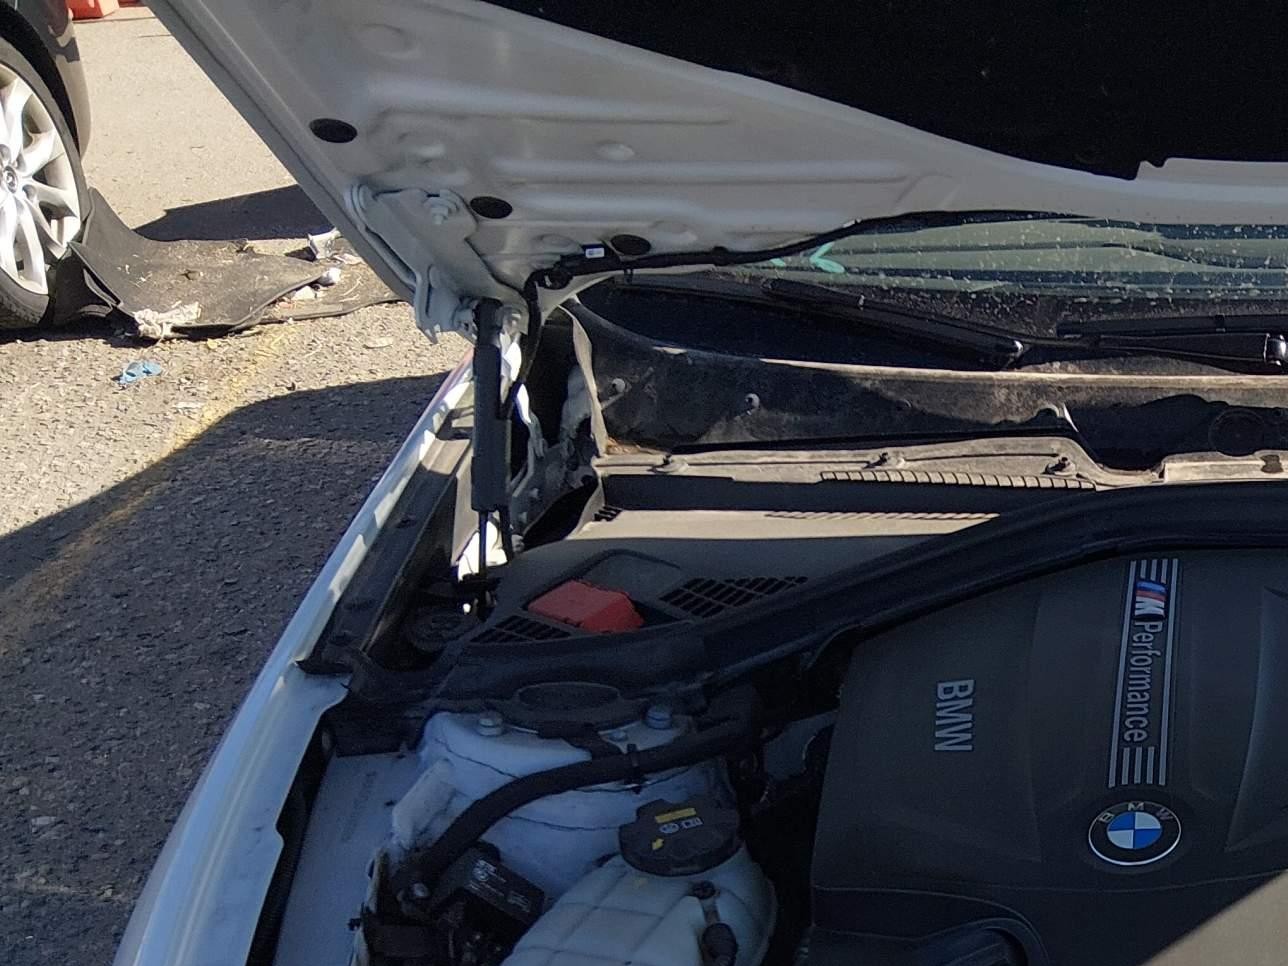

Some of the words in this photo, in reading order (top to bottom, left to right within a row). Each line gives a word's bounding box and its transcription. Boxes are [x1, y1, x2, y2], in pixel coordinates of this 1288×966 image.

[934, 679, 975, 751] BMW
[1123, 620, 1163, 743] Performance
[1098, 802, 1174, 823] BMW
